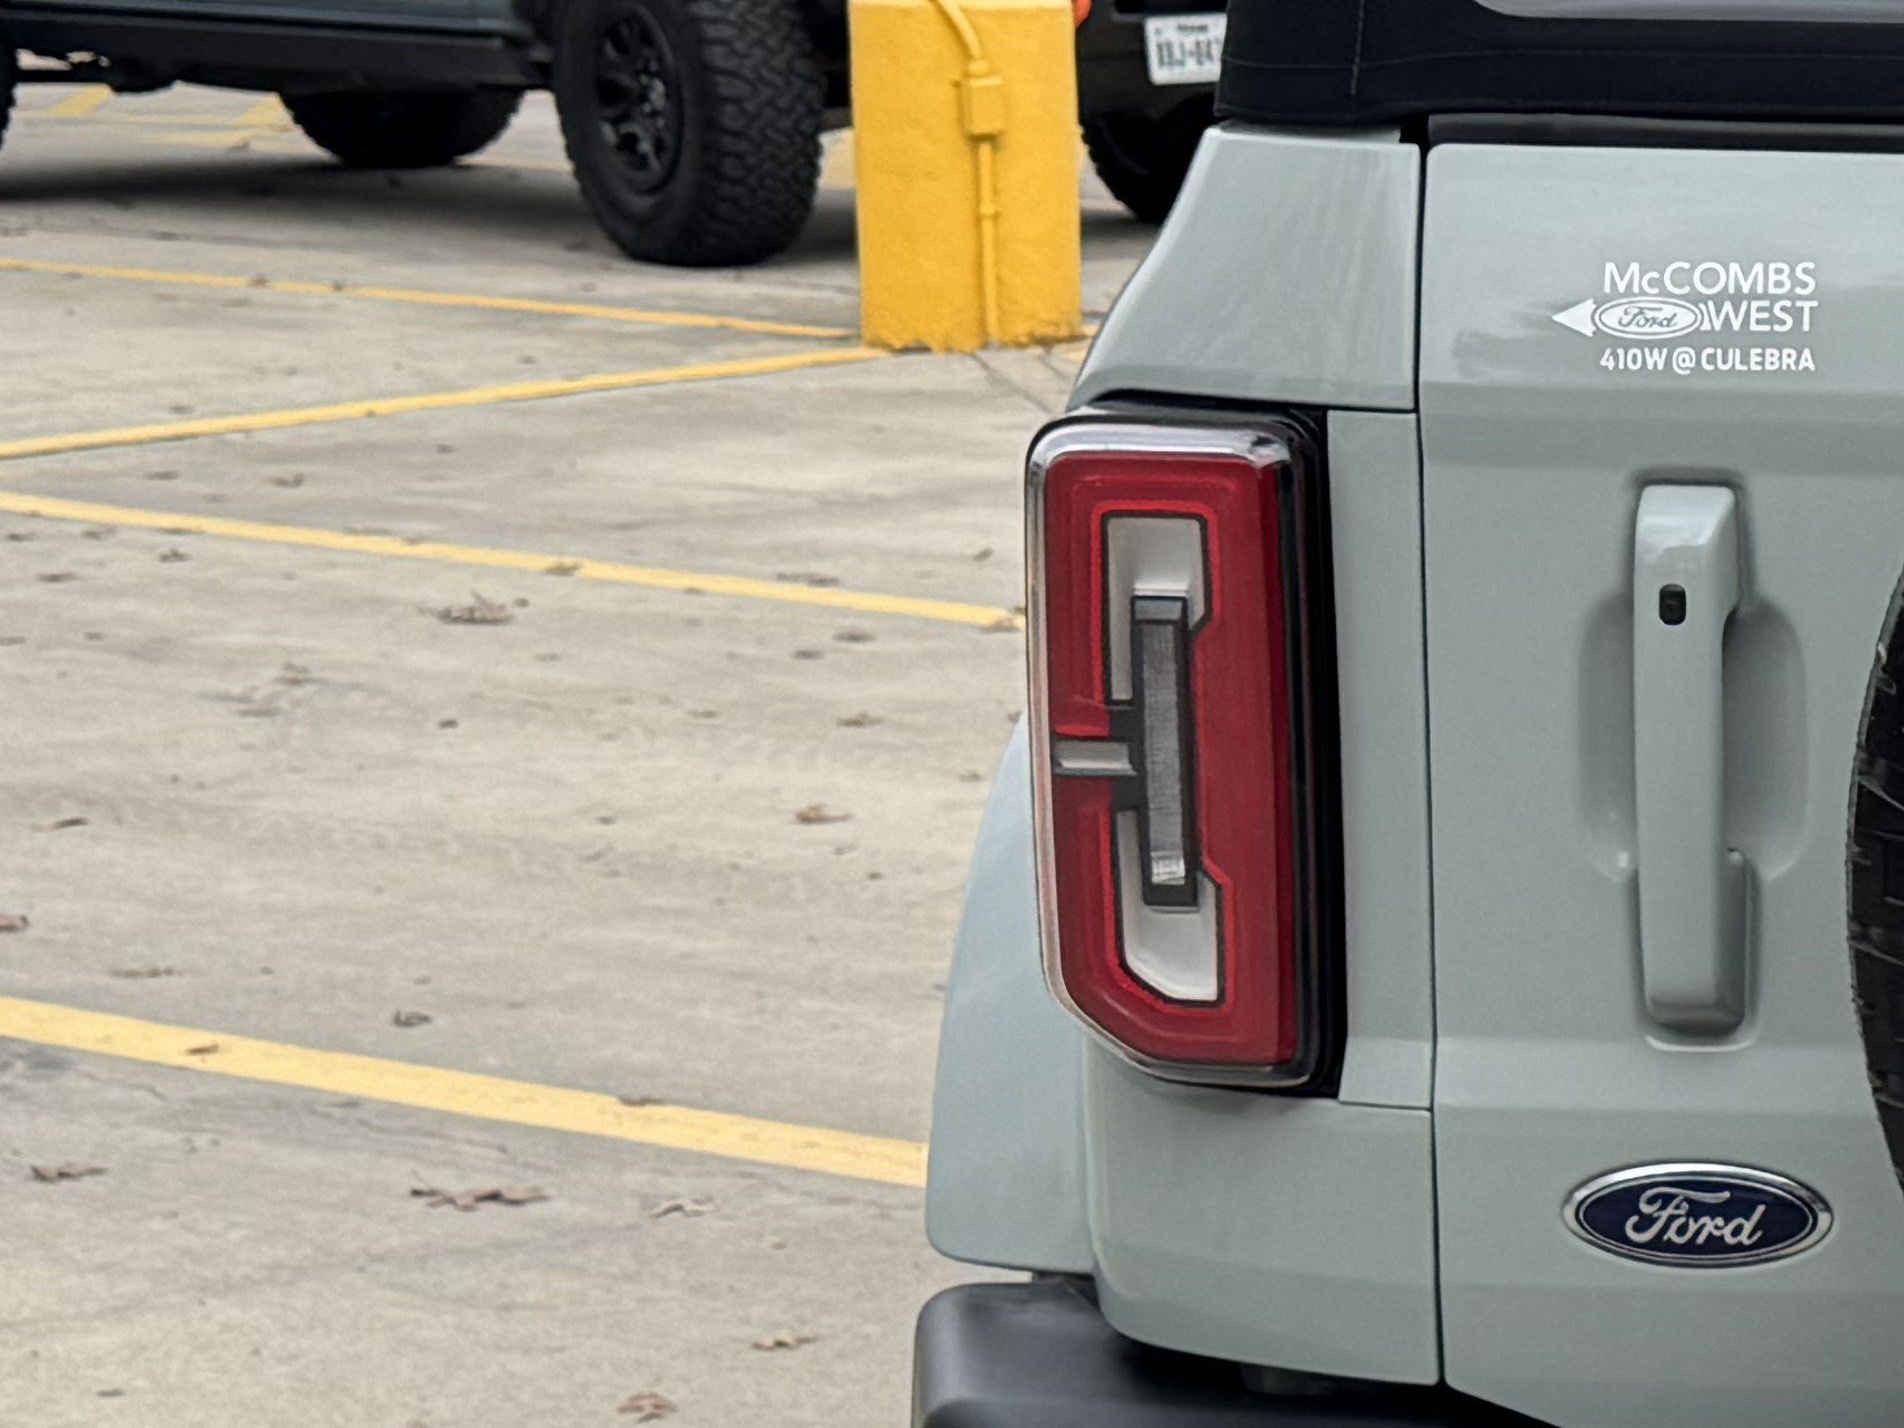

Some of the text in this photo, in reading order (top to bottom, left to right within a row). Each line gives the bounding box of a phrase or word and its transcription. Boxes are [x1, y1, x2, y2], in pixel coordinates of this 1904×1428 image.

[1603, 261, 1816, 295] McCOMBS
[1618, 305, 1678, 328] Ford
[1707, 300, 1819, 332] WEST
[1700, 346, 1816, 371] CULEBRA
[1624, 1186, 1767, 1246] Ford
